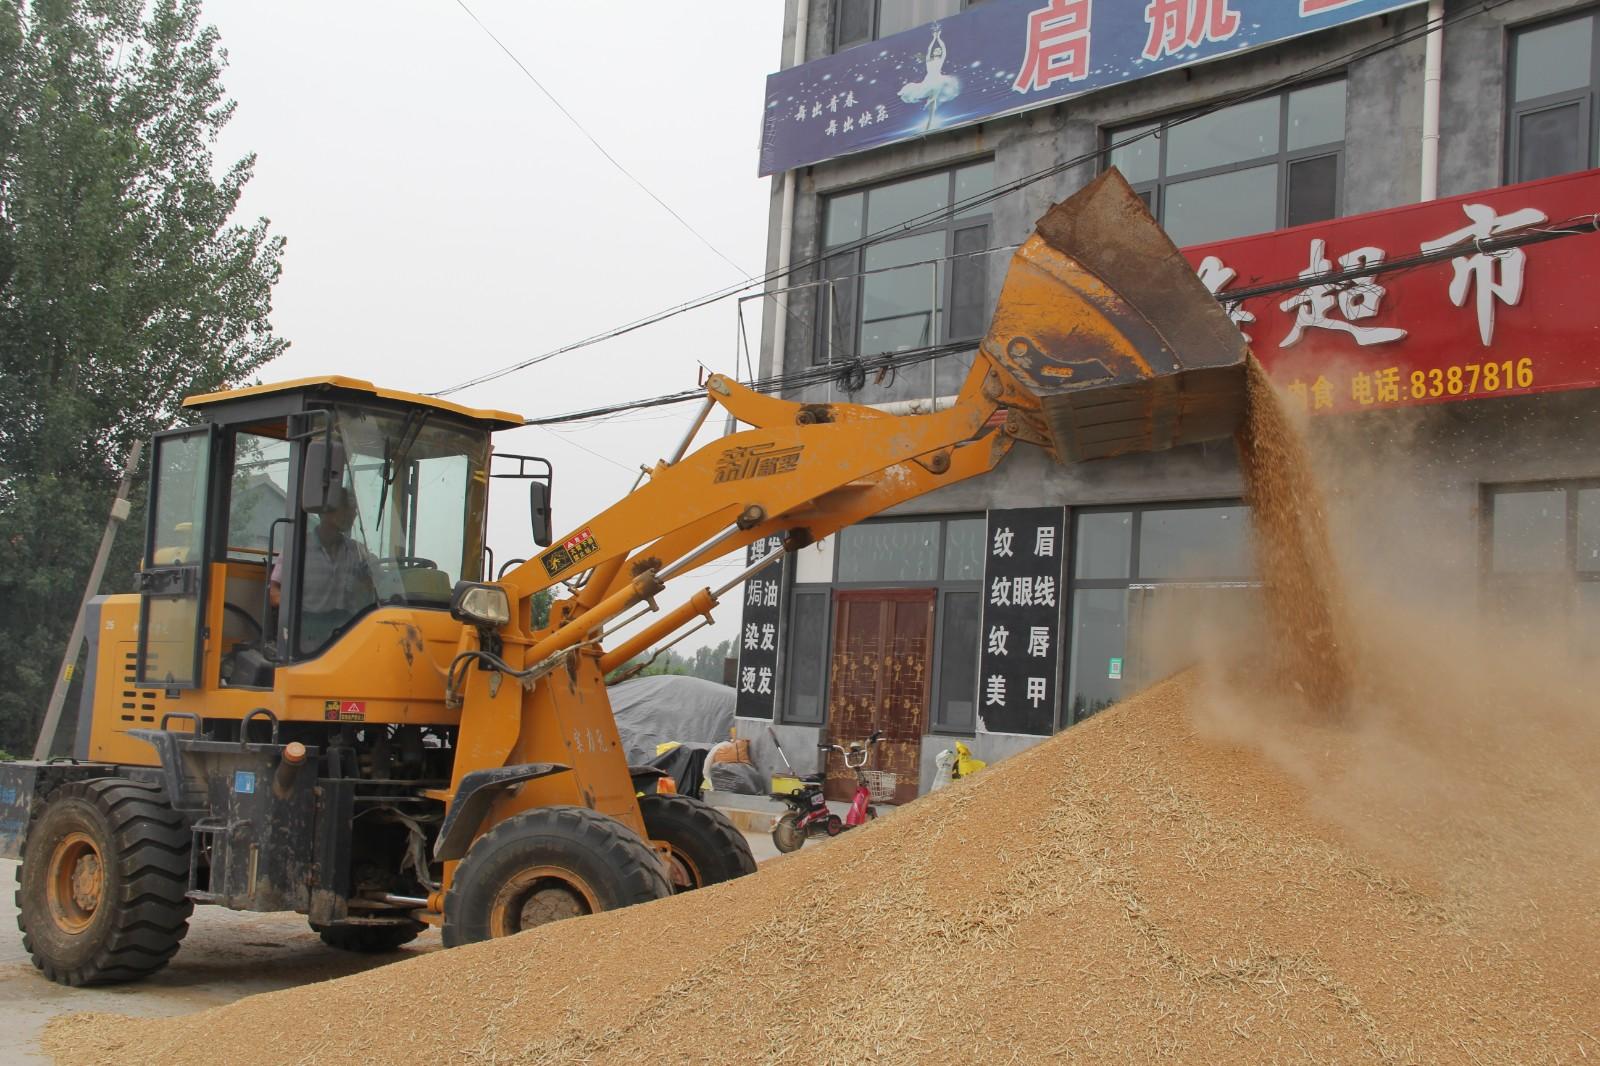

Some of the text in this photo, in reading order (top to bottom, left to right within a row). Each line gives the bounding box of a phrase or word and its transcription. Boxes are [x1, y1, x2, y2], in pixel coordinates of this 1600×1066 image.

[1012, 0, 1359, 93] 启航
[794, 90, 859, 121] 舞出青春
[992, 526, 1055, 557] 纹眉
[746, 579, 779, 607] 焗油
[990, 575, 1056, 608] 纹眼线
[744, 623, 776, 650] 染发
[987, 625, 1050, 657] 纹唇
[741, 666, 773, 694] 烫发
[986, 674, 1047, 708] 美甲
